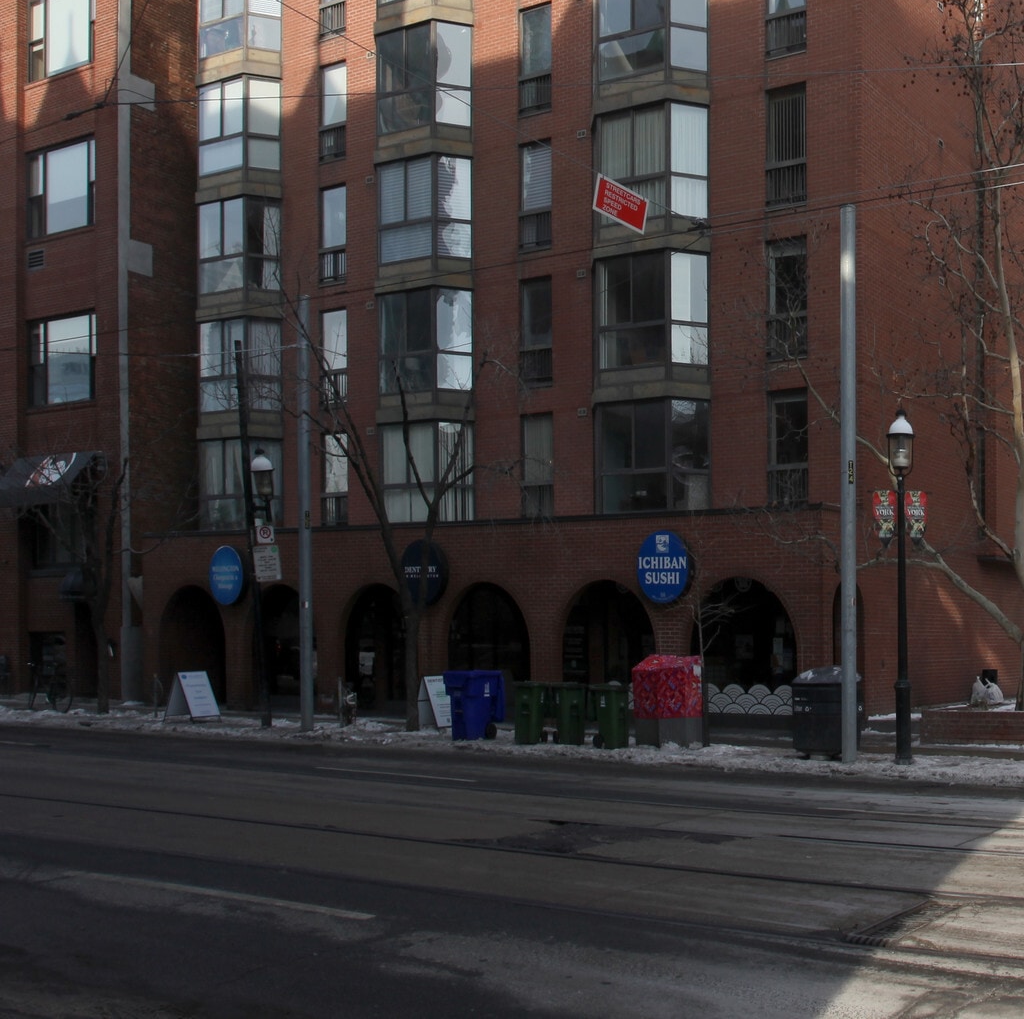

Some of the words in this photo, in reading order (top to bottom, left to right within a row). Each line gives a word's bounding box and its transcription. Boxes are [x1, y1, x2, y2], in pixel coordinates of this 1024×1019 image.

[604, 189, 639, 211] RESTRICTED
[606, 182, 641, 205] STREETCARS
[602, 204, 618, 217] ZONE
[603, 197, 622, 211] SPEED
[875, 508, 895, 516] YORK
[638, 556, 687, 569] ICHIBAN
[645, 572, 680, 584] SUSHI
